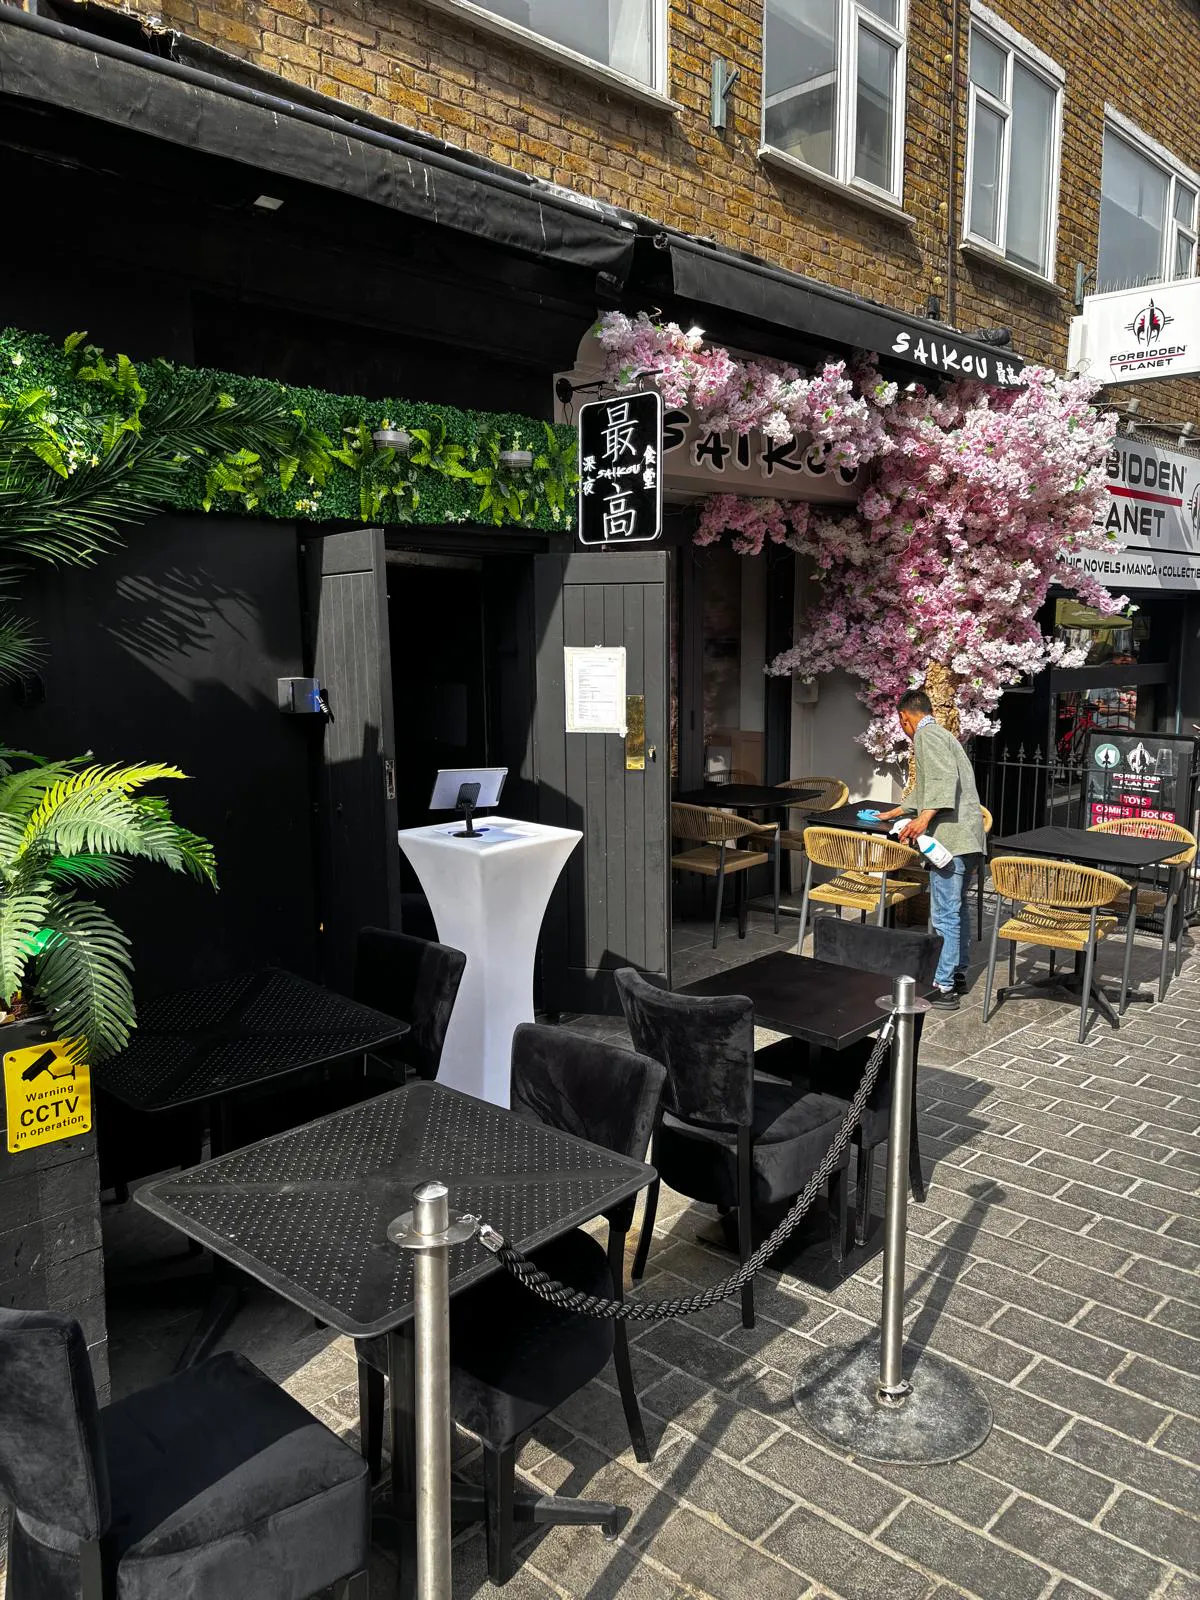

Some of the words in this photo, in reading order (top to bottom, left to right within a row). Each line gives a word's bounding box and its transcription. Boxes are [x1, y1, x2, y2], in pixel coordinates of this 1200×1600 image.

[892, 332, 988, 379] SAIKOU
[1109, 345, 1187, 363] FORBIDDEN
[1120, 358, 1173, 372] PLANET
[596, 463, 641, 480] SAIKOU
[601, 402, 639, 539] 最高
[1105, 448, 1185, 494] BIDDEN
[1094, 502, 1166, 538] ANET
[1083, 559, 1121, 574] NOVELS
[1126, 562, 1158, 576] MANGA
[26, 1084, 74, 1102] Warning
[20, 1096, 79, 1127] CCTV
[16, 1131, 27, 1140] in
[30, 1115, 84, 1136] operation
